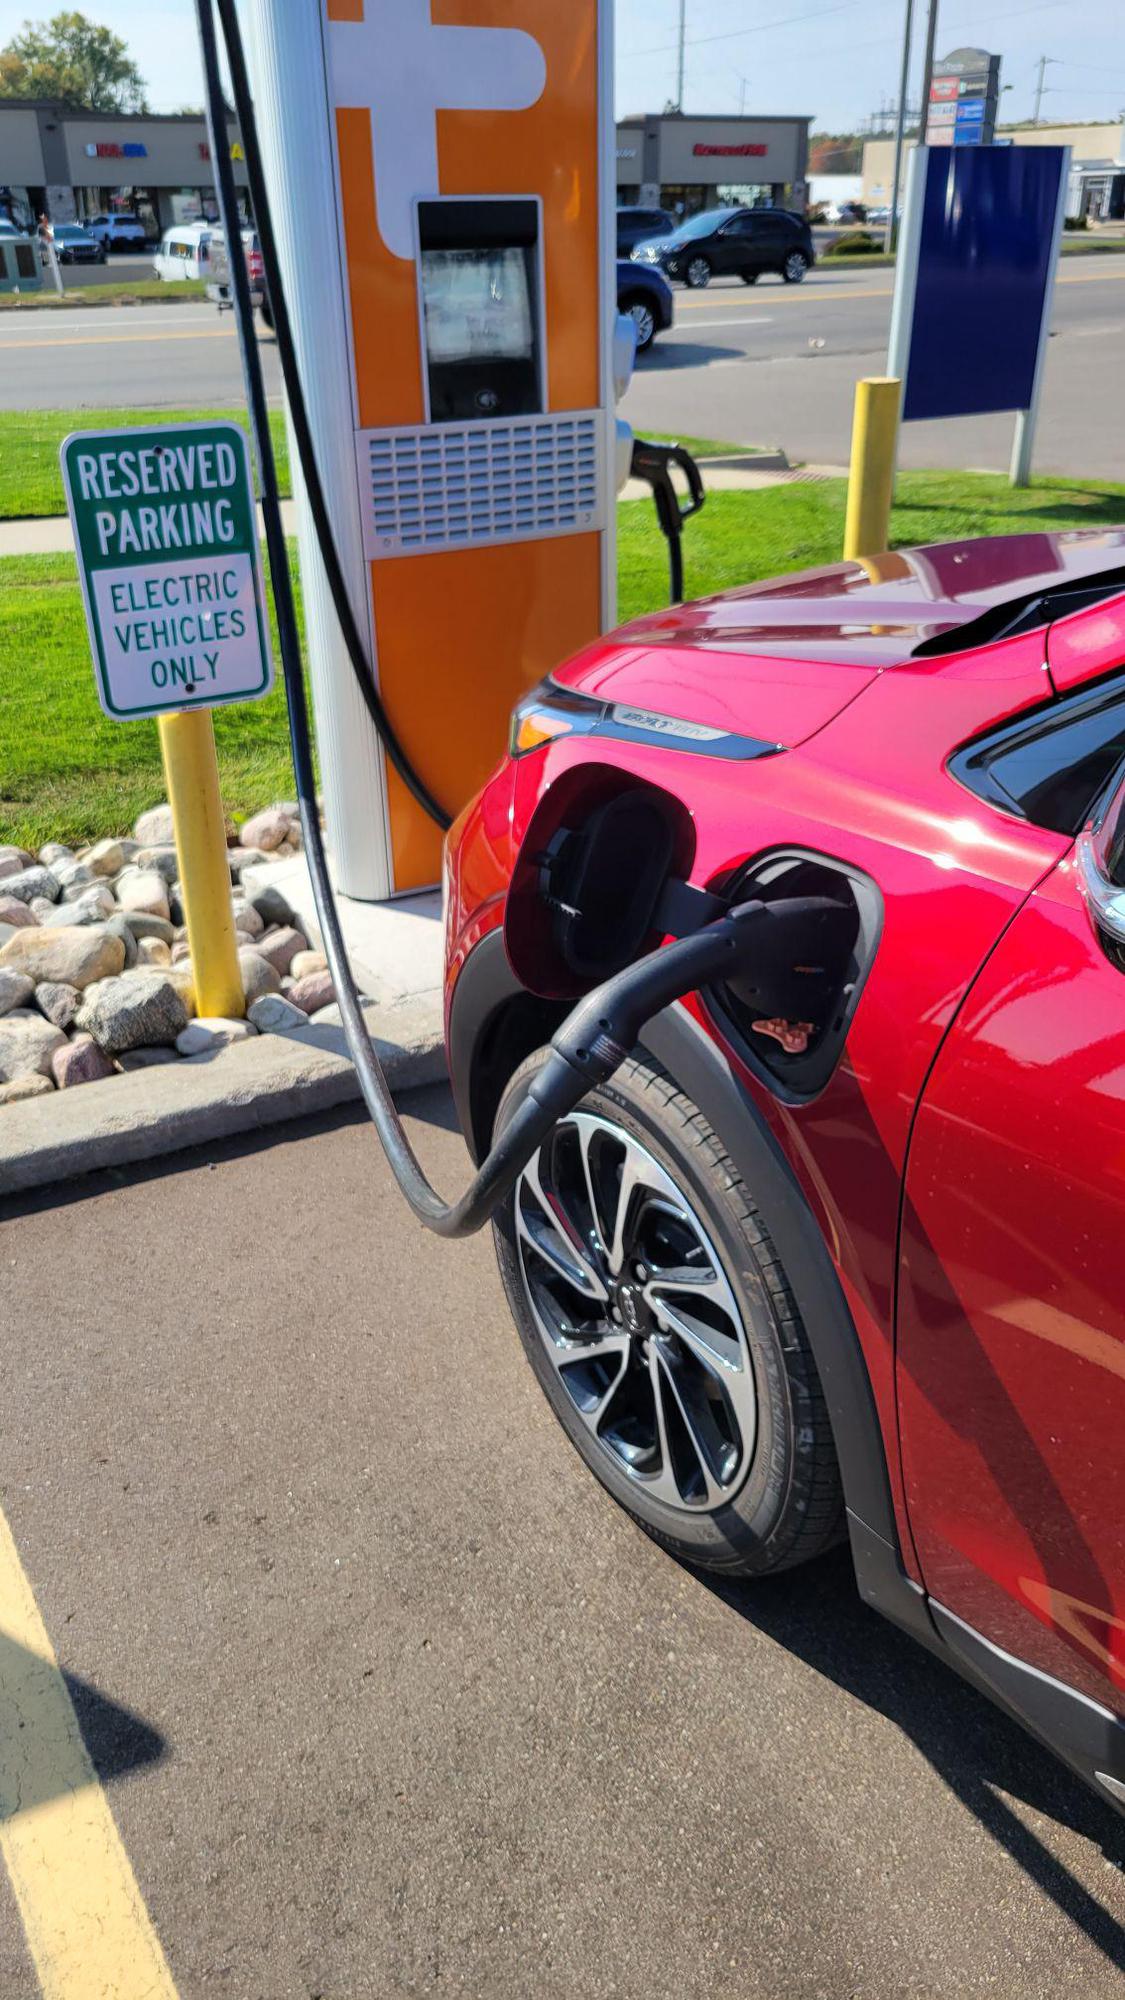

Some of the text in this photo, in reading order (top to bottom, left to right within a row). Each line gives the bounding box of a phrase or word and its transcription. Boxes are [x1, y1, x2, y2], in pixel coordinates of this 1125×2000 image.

[77, 443, 237, 500] RESERVED
[96, 498, 235, 556] PARKING
[110, 570, 239, 614] ELECTRIC
[114, 609, 247, 654] VEHICLES
[150, 651, 220, 689] ONLY
